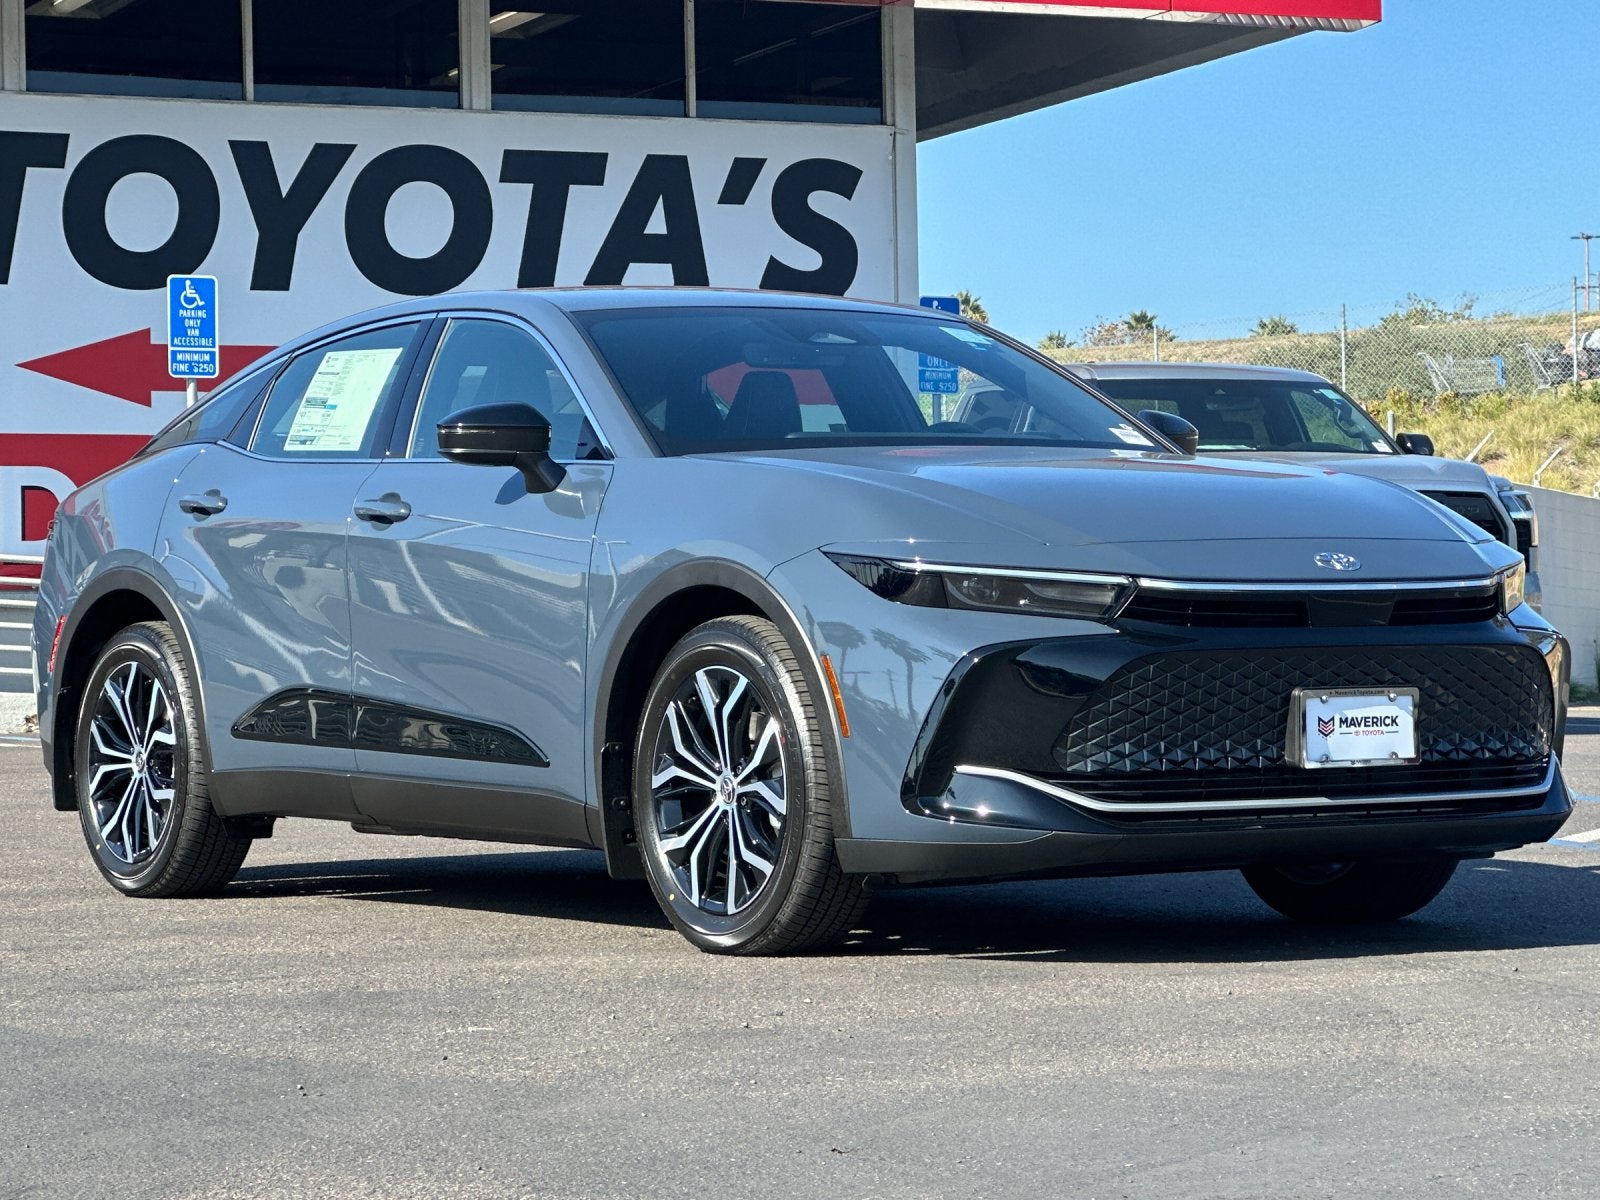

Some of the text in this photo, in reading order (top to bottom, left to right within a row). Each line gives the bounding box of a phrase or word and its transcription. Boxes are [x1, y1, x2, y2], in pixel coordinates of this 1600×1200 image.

[0, 130, 864, 296] TOYOTA'S
[179, 309, 207, 319] PARKING
[184, 319, 201, 328] ONLY
[187, 328, 200, 337] VAN
[173, 337, 213, 347] ACCESSIBLE
[176, 352, 210, 362] MINIMUM
[172, 362, 214, 373] FINE $250
[1339, 715, 1399, 729] MAVERICK
[1361, 729, 1385, 737] TOYOTA
